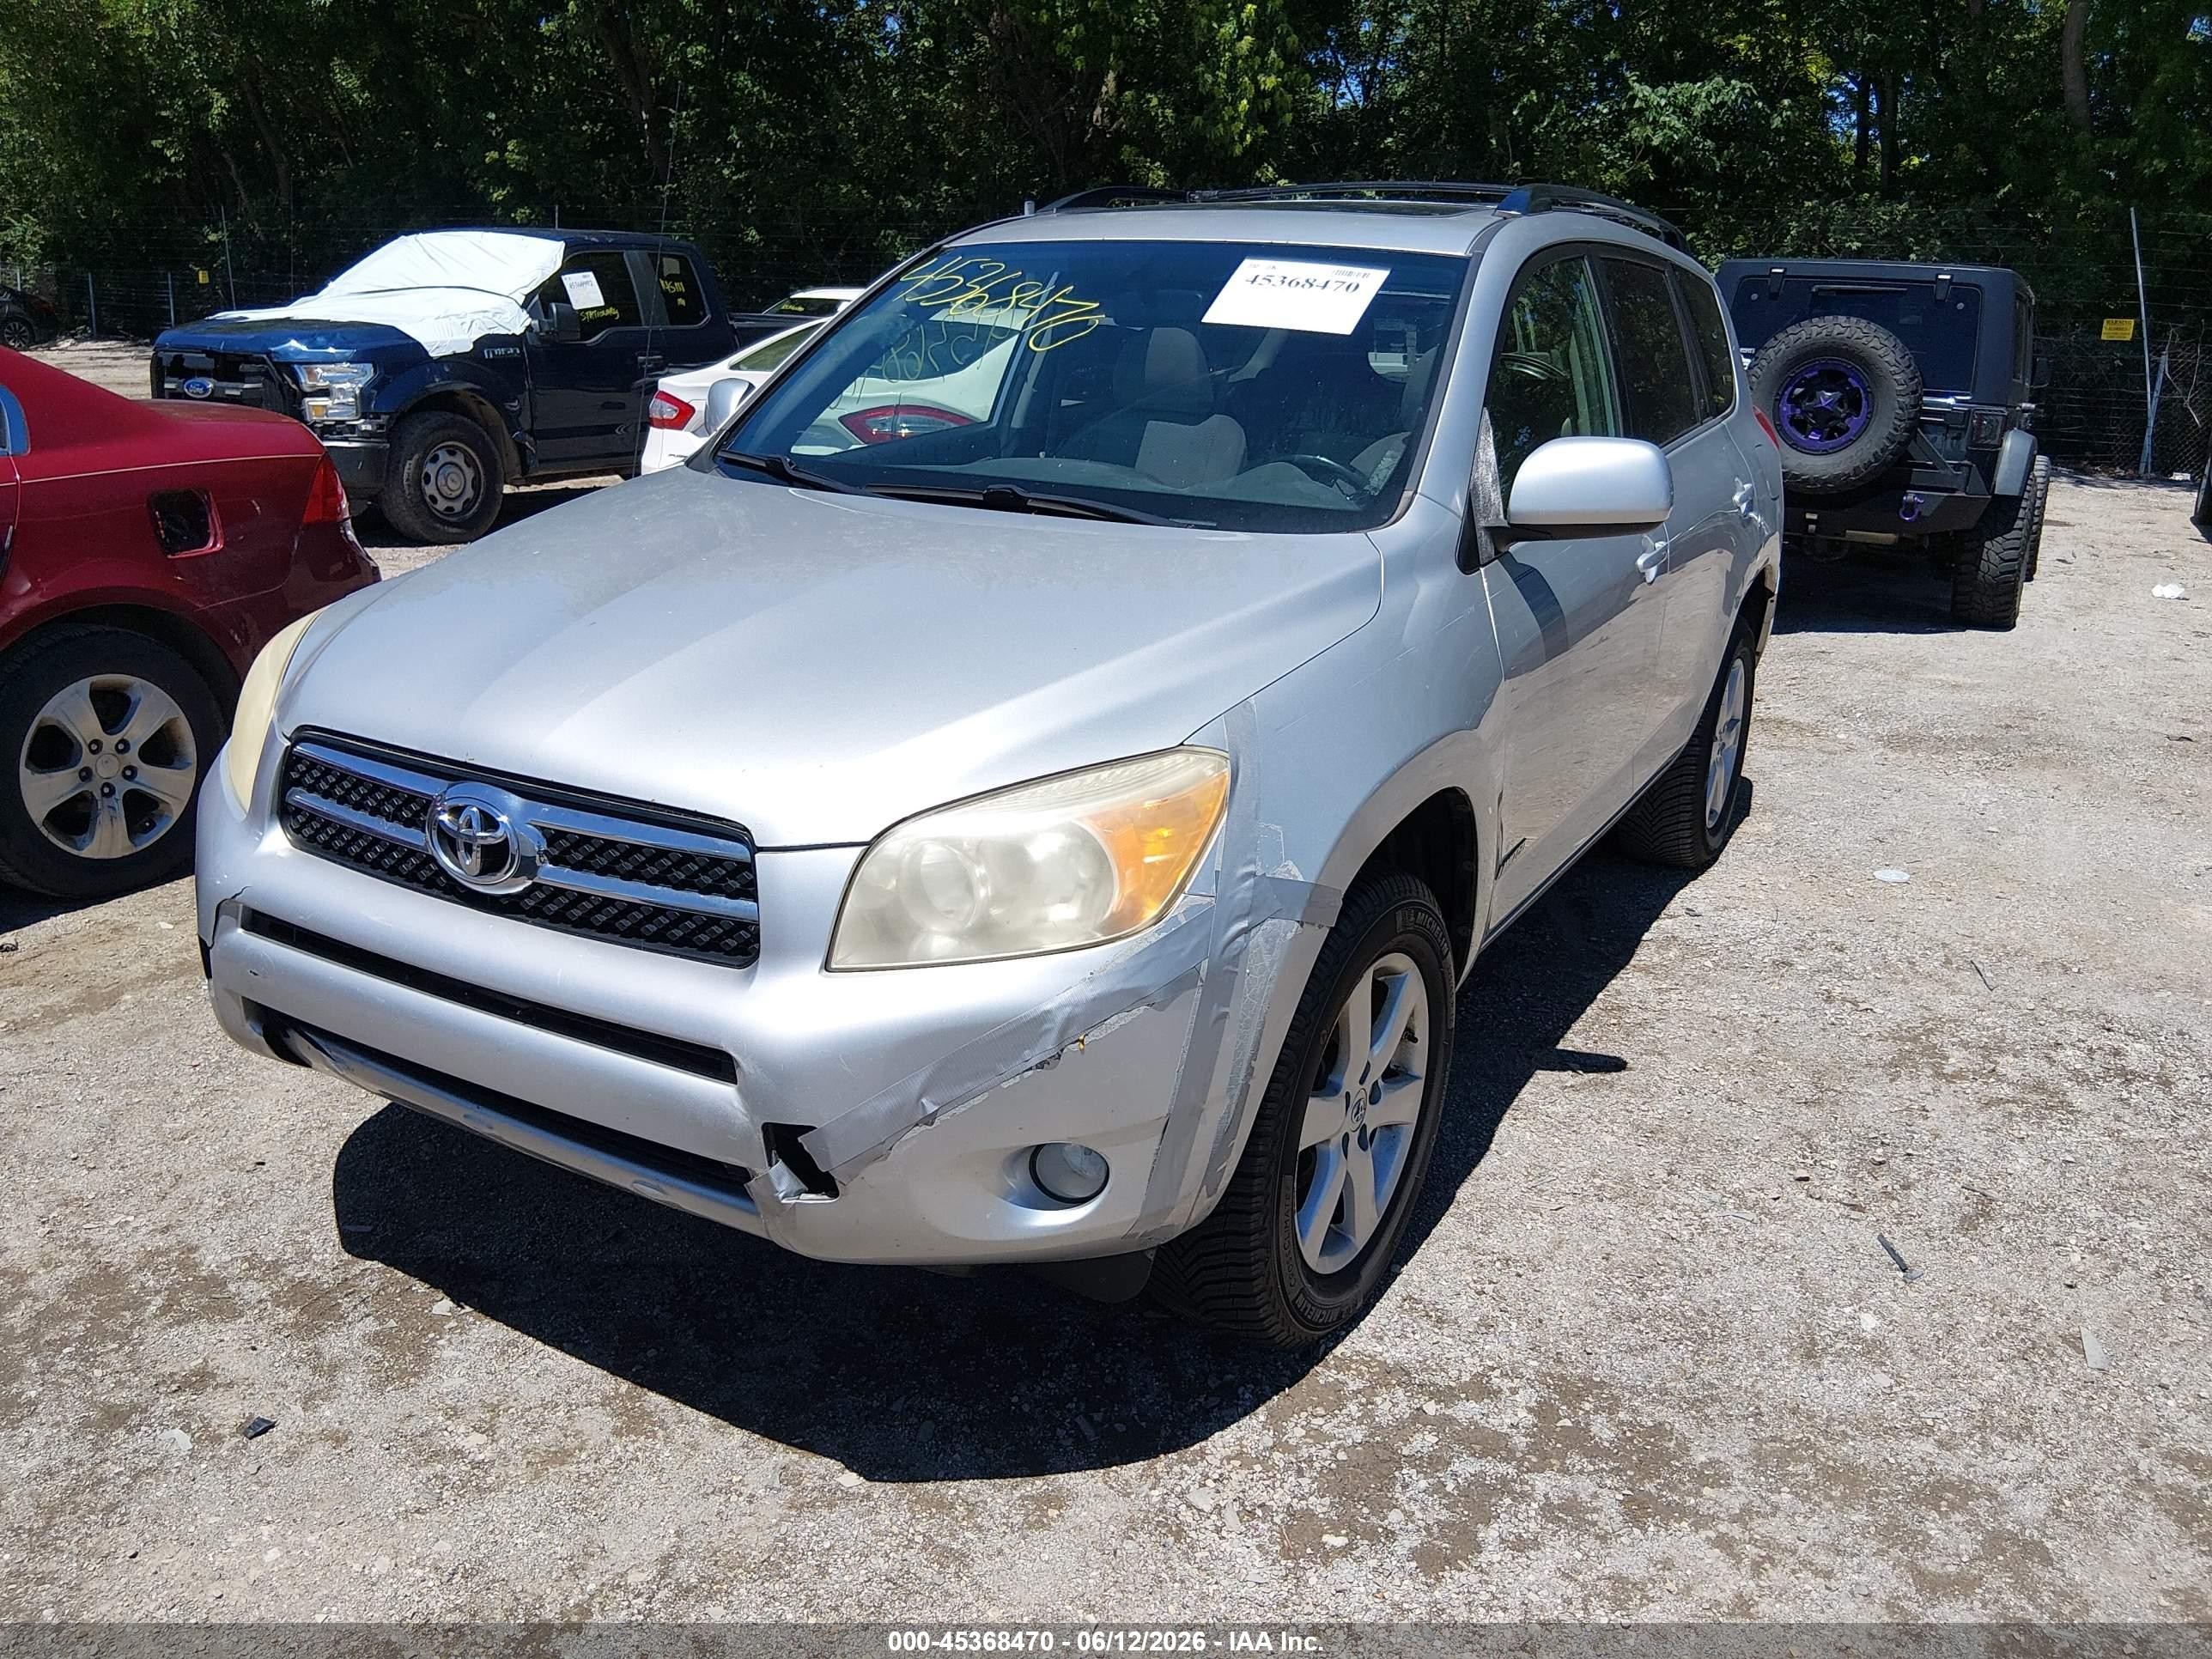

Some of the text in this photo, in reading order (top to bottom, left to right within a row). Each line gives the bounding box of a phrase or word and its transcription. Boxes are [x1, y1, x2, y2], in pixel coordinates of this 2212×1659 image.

[1245, 273, 1360, 294] 45368470
[1417, 910, 1449, 957] MICHELIN
[1295, 1291, 1340, 1323] MICHELIN
